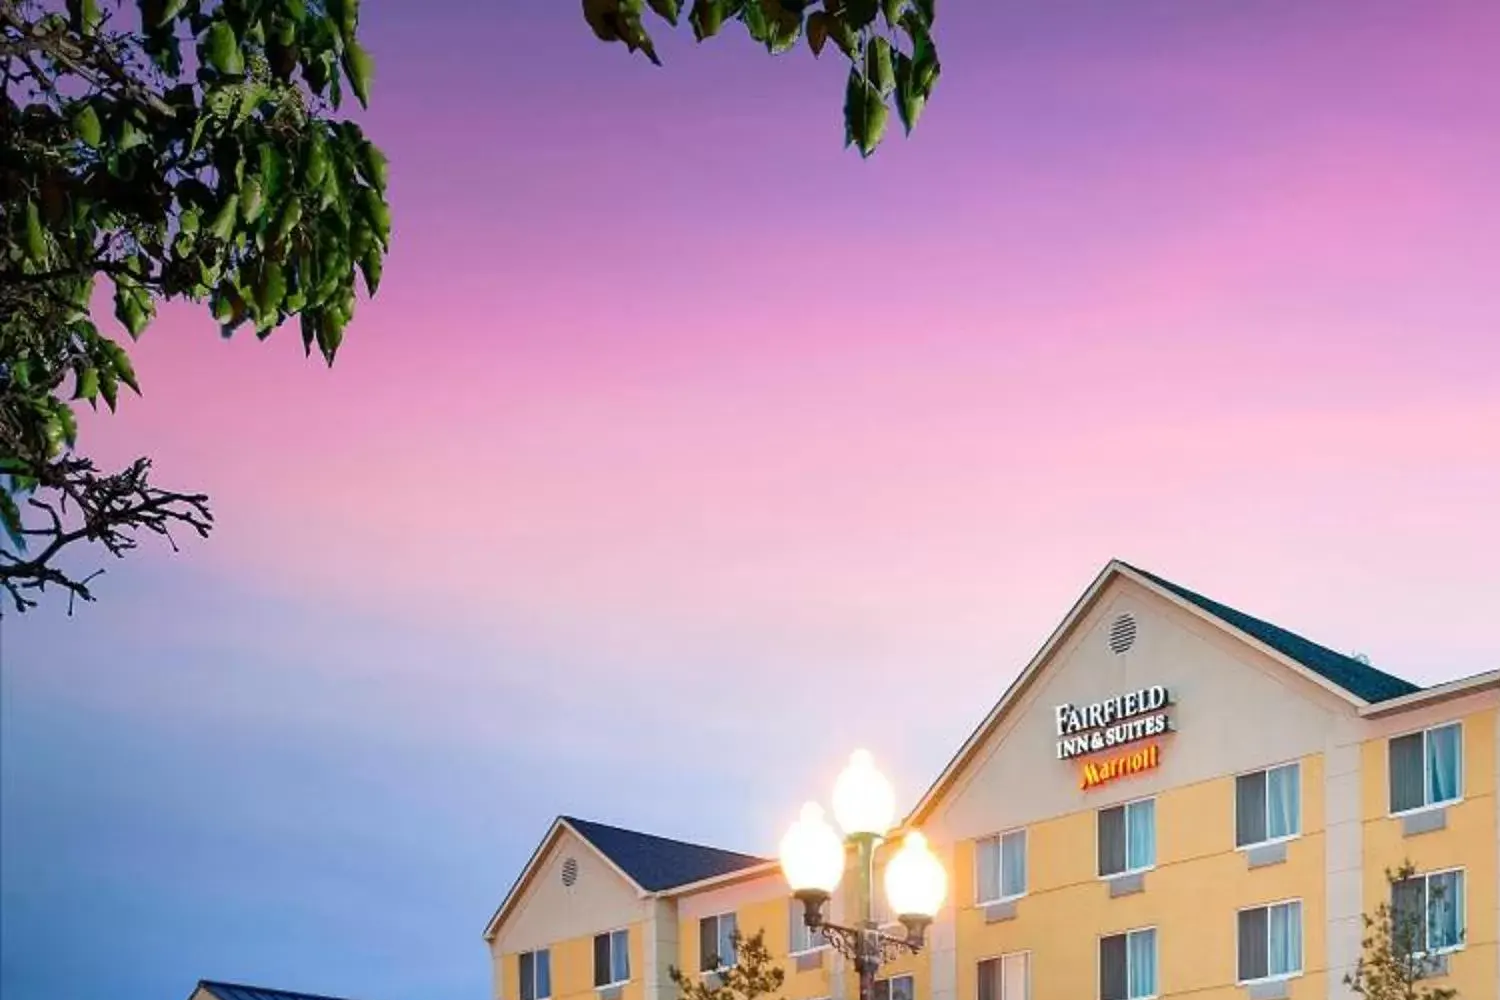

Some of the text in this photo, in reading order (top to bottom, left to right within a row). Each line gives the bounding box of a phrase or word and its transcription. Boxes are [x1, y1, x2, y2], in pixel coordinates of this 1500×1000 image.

[1055, 685, 1168, 736] FAIRFIELD
[1056, 733, 1089, 759] INN
[1105, 714, 1168, 747] SUITES
[1080, 743, 1159, 790] Marriott
